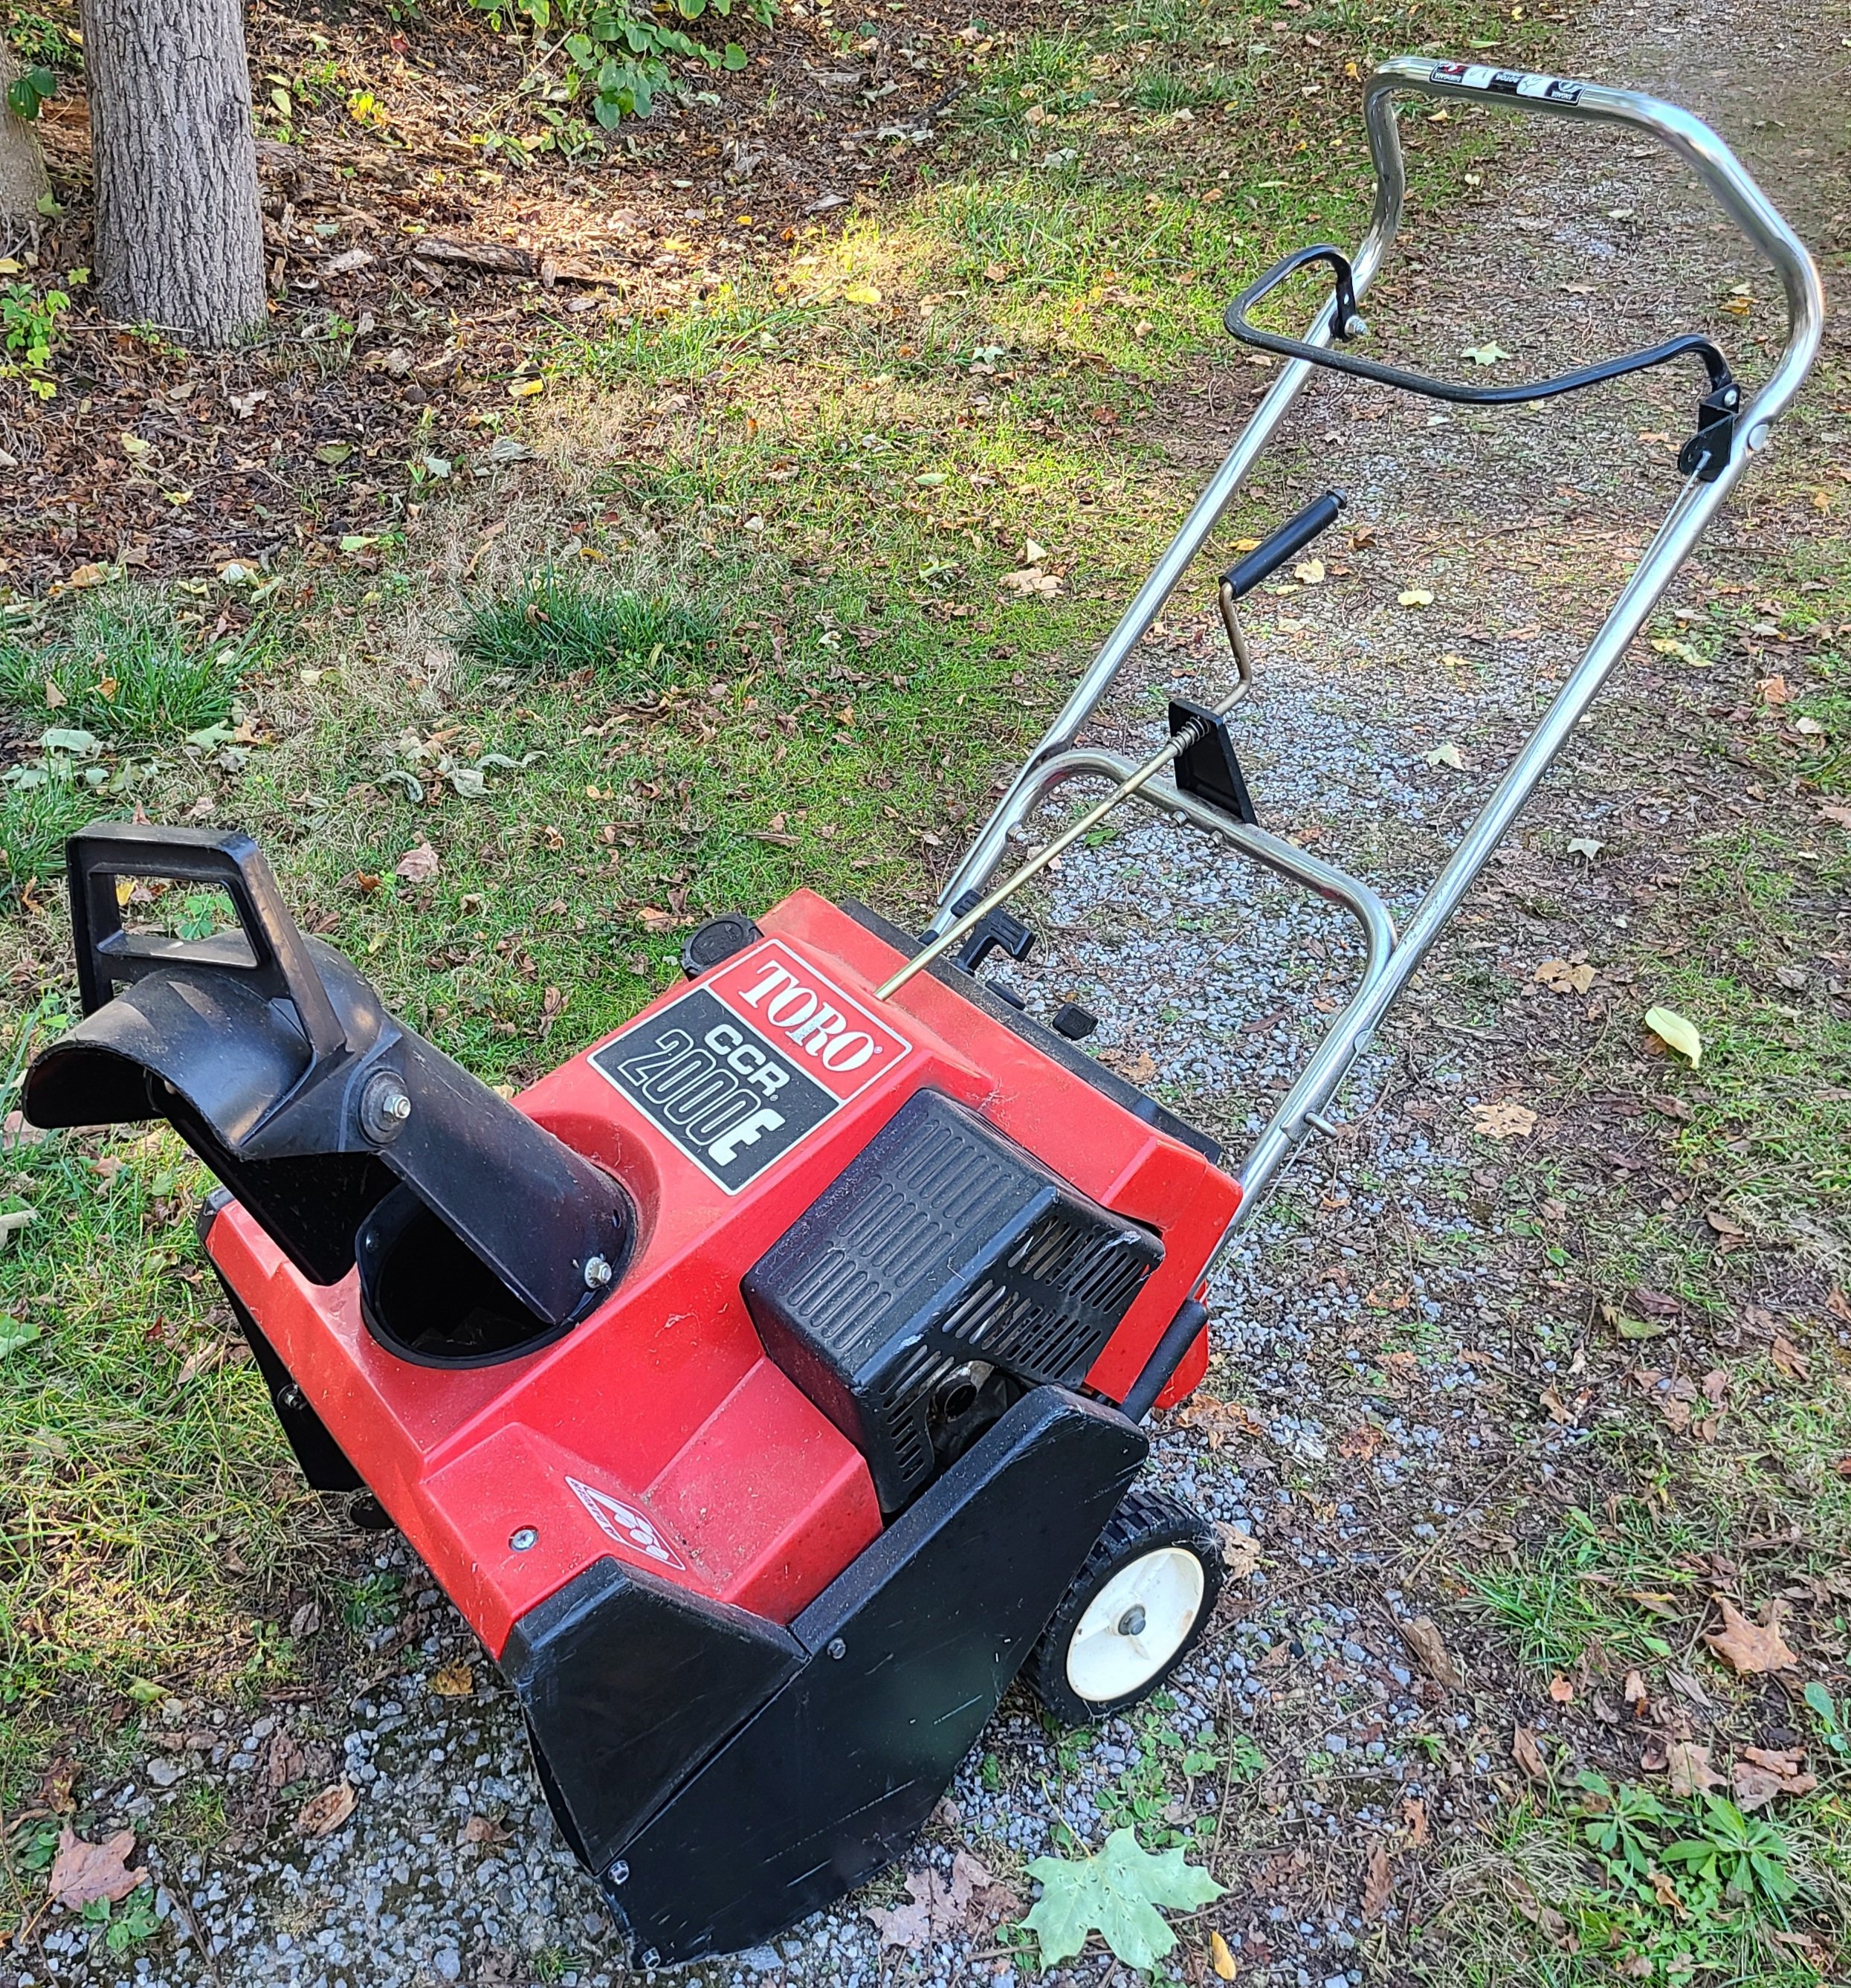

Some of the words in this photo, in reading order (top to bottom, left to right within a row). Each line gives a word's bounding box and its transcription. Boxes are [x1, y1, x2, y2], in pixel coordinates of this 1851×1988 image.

[704, 1023, 790, 1098] CCR
[738, 959, 876, 1072] TORO
[617, 1028, 786, 1167] 2000E
